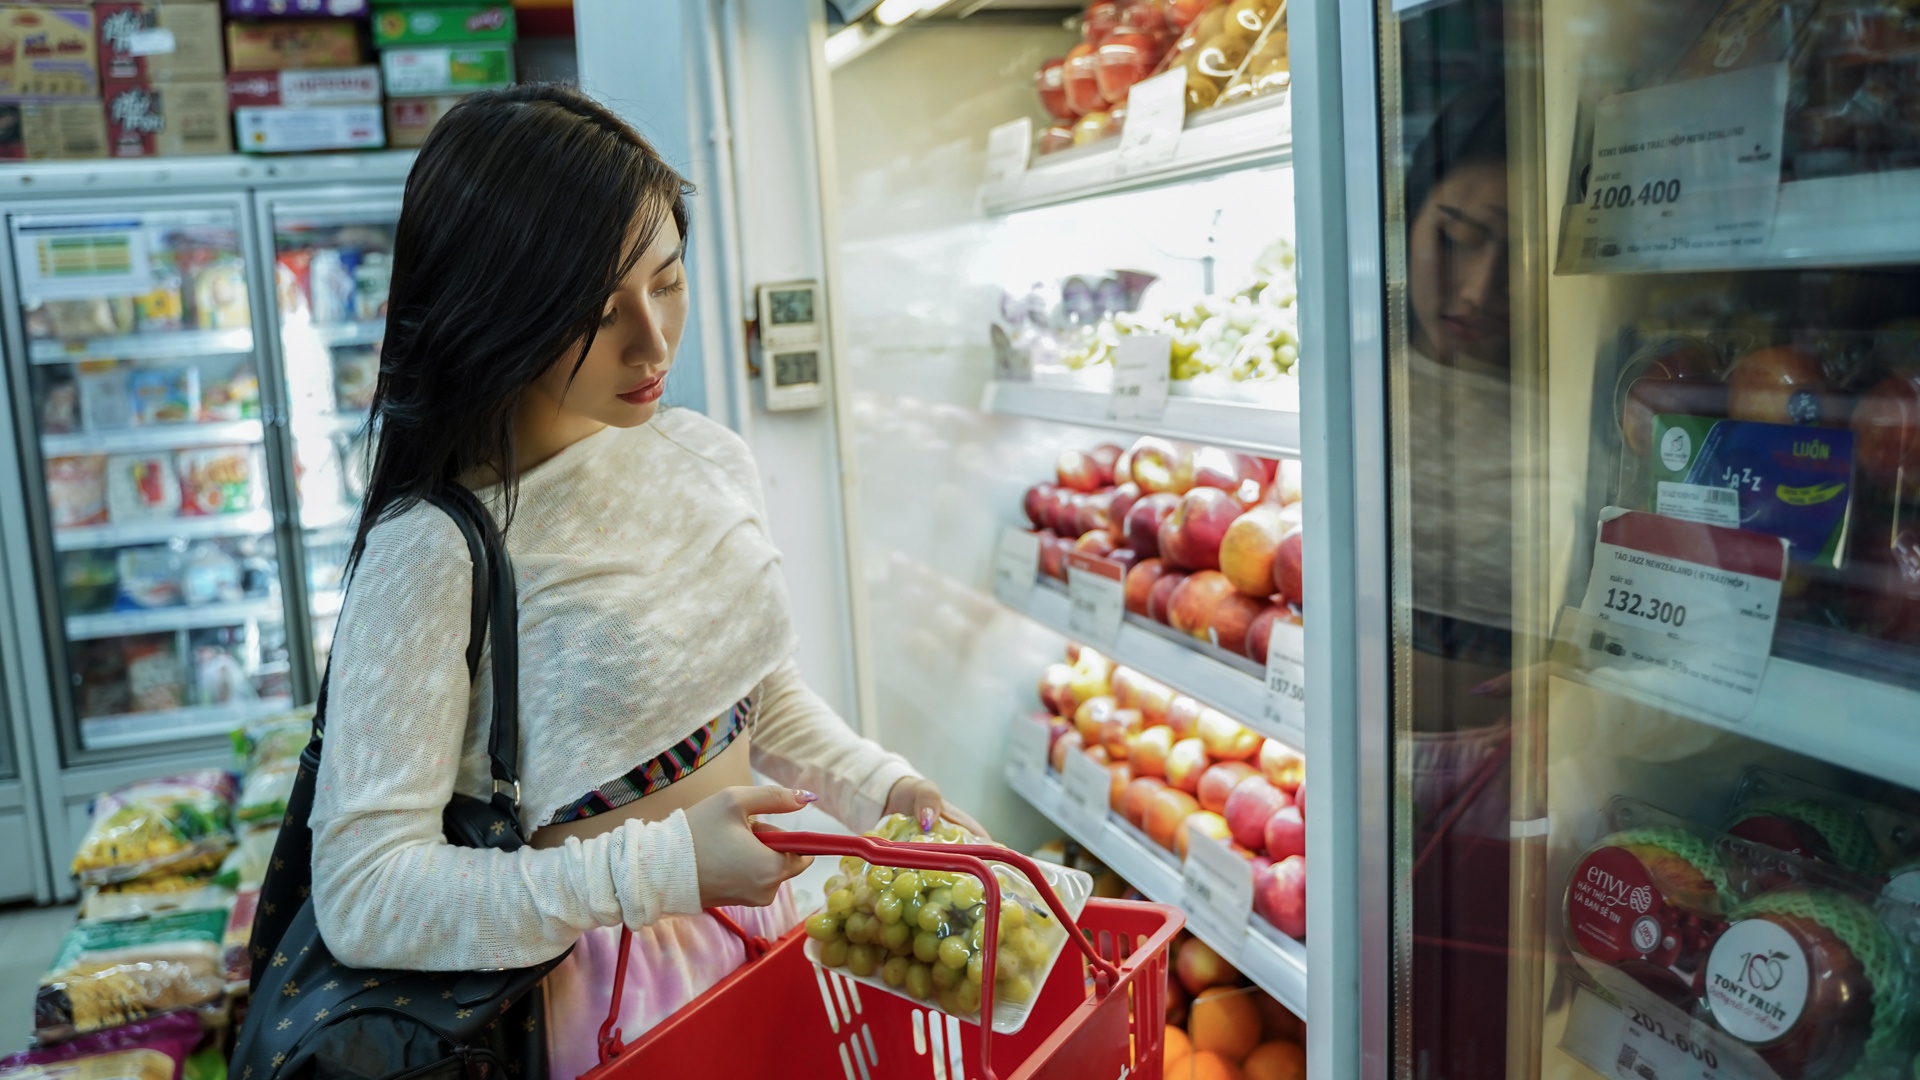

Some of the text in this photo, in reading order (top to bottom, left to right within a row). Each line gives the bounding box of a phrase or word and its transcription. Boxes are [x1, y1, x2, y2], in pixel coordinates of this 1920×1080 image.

[1590, 178, 1681, 210] 100.400
[1669, 236, 1691, 251] 3%
[1793, 439, 1831, 460] LUÔN
[1722, 466, 1762, 491] JAZZ
[1614, 550, 1627, 562] TÁO
[1628, 554, 1644, 566] JAZZ
[1645, 558, 1693, 578] NEWZEALAND
[1604, 587, 1686, 628] 132.300
[1671, 658, 1690, 675] 3%
[1576, 881, 1592, 894] HÃY
[1587, 866, 1631, 907] envy
[1573, 891, 1622, 924] VÀ BẠN SẼ TIN
[1714, 973, 1787, 1022] TONY FRUIT
[1628, 1004, 1718, 1069] 201.600
